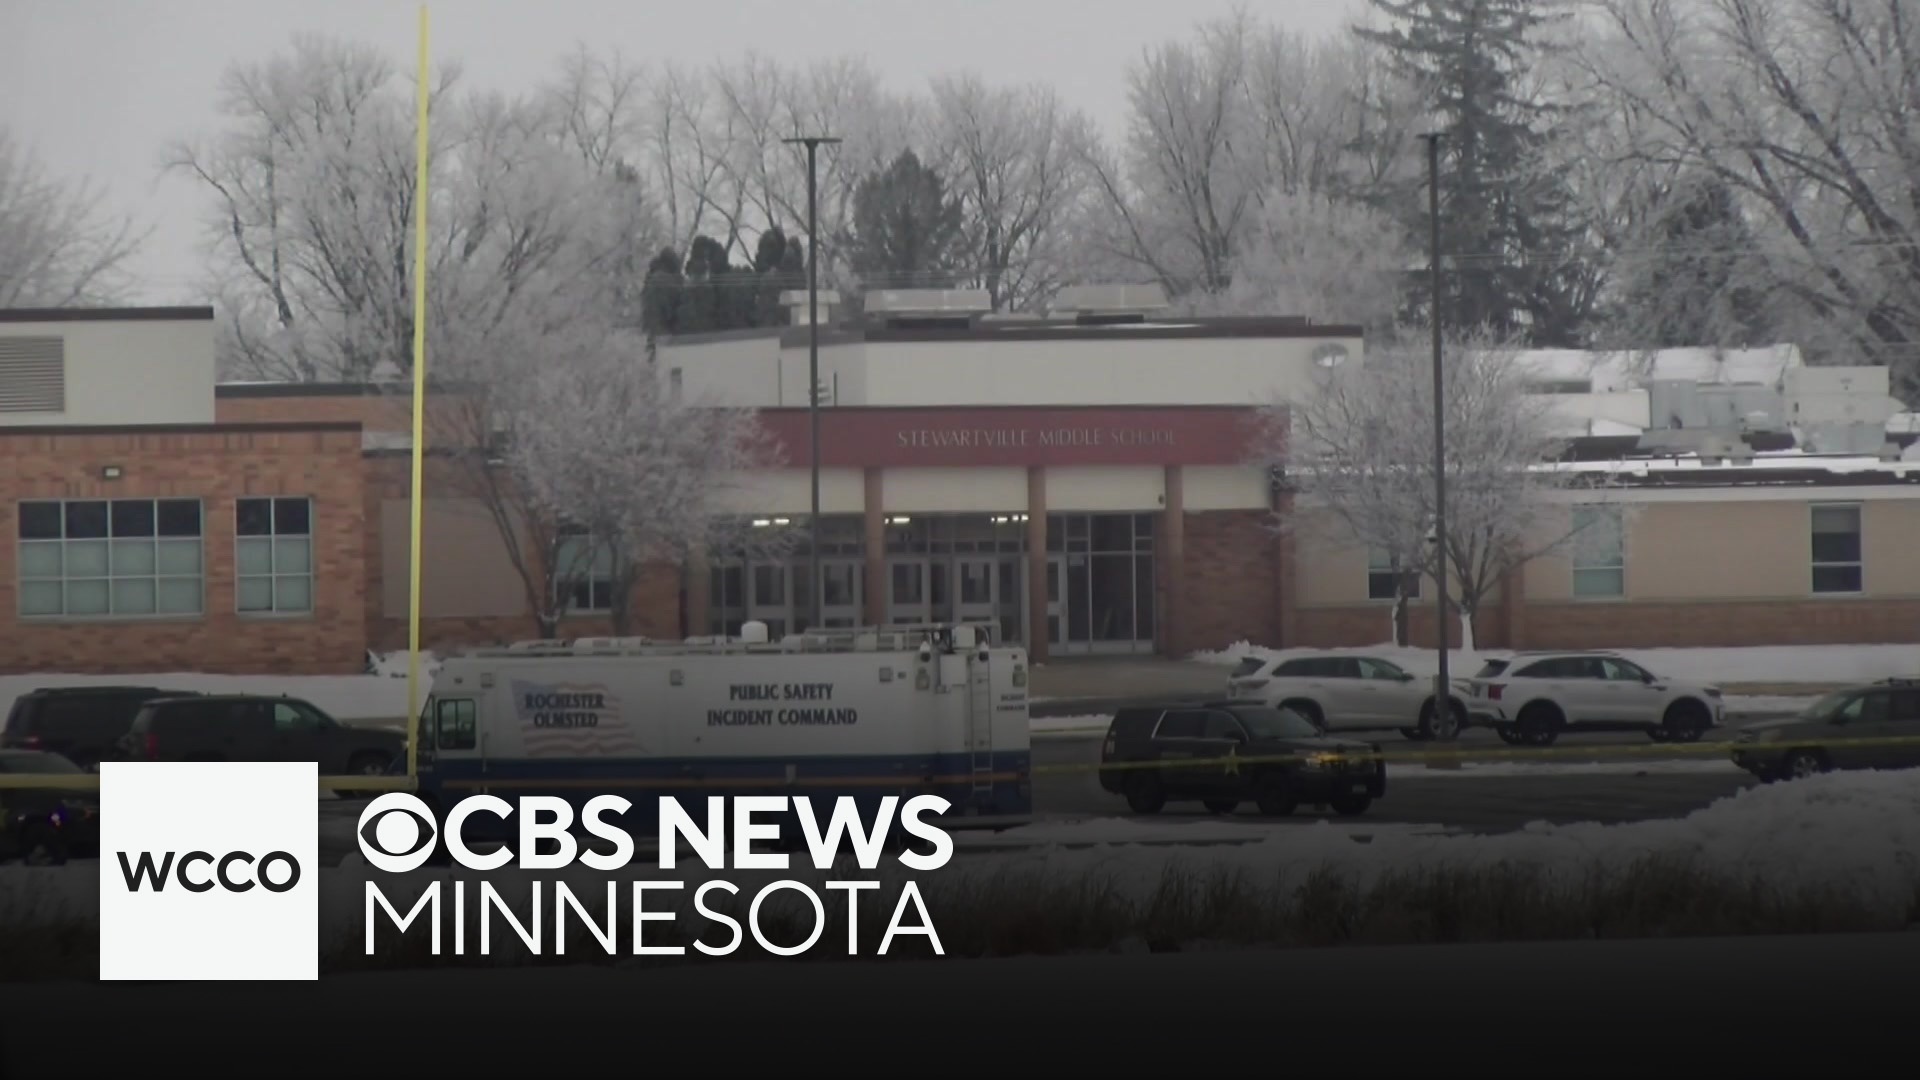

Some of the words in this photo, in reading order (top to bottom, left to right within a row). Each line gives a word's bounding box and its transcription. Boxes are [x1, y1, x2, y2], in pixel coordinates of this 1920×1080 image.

[898, 429, 1028, 447] STEWARTVILLE
[1039, 428, 1101, 446] MIDDLE
[1110, 428, 1177, 446] SCHOOL
[729, 684, 780, 700] PUBLIC
[783, 683, 834, 700] SAFETY
[524, 693, 605, 709] ROCHESTER
[534, 712, 599, 727] OLMSTED
[706, 710, 773, 726] INCIDENT
[777, 708, 858, 725] COMMAND
